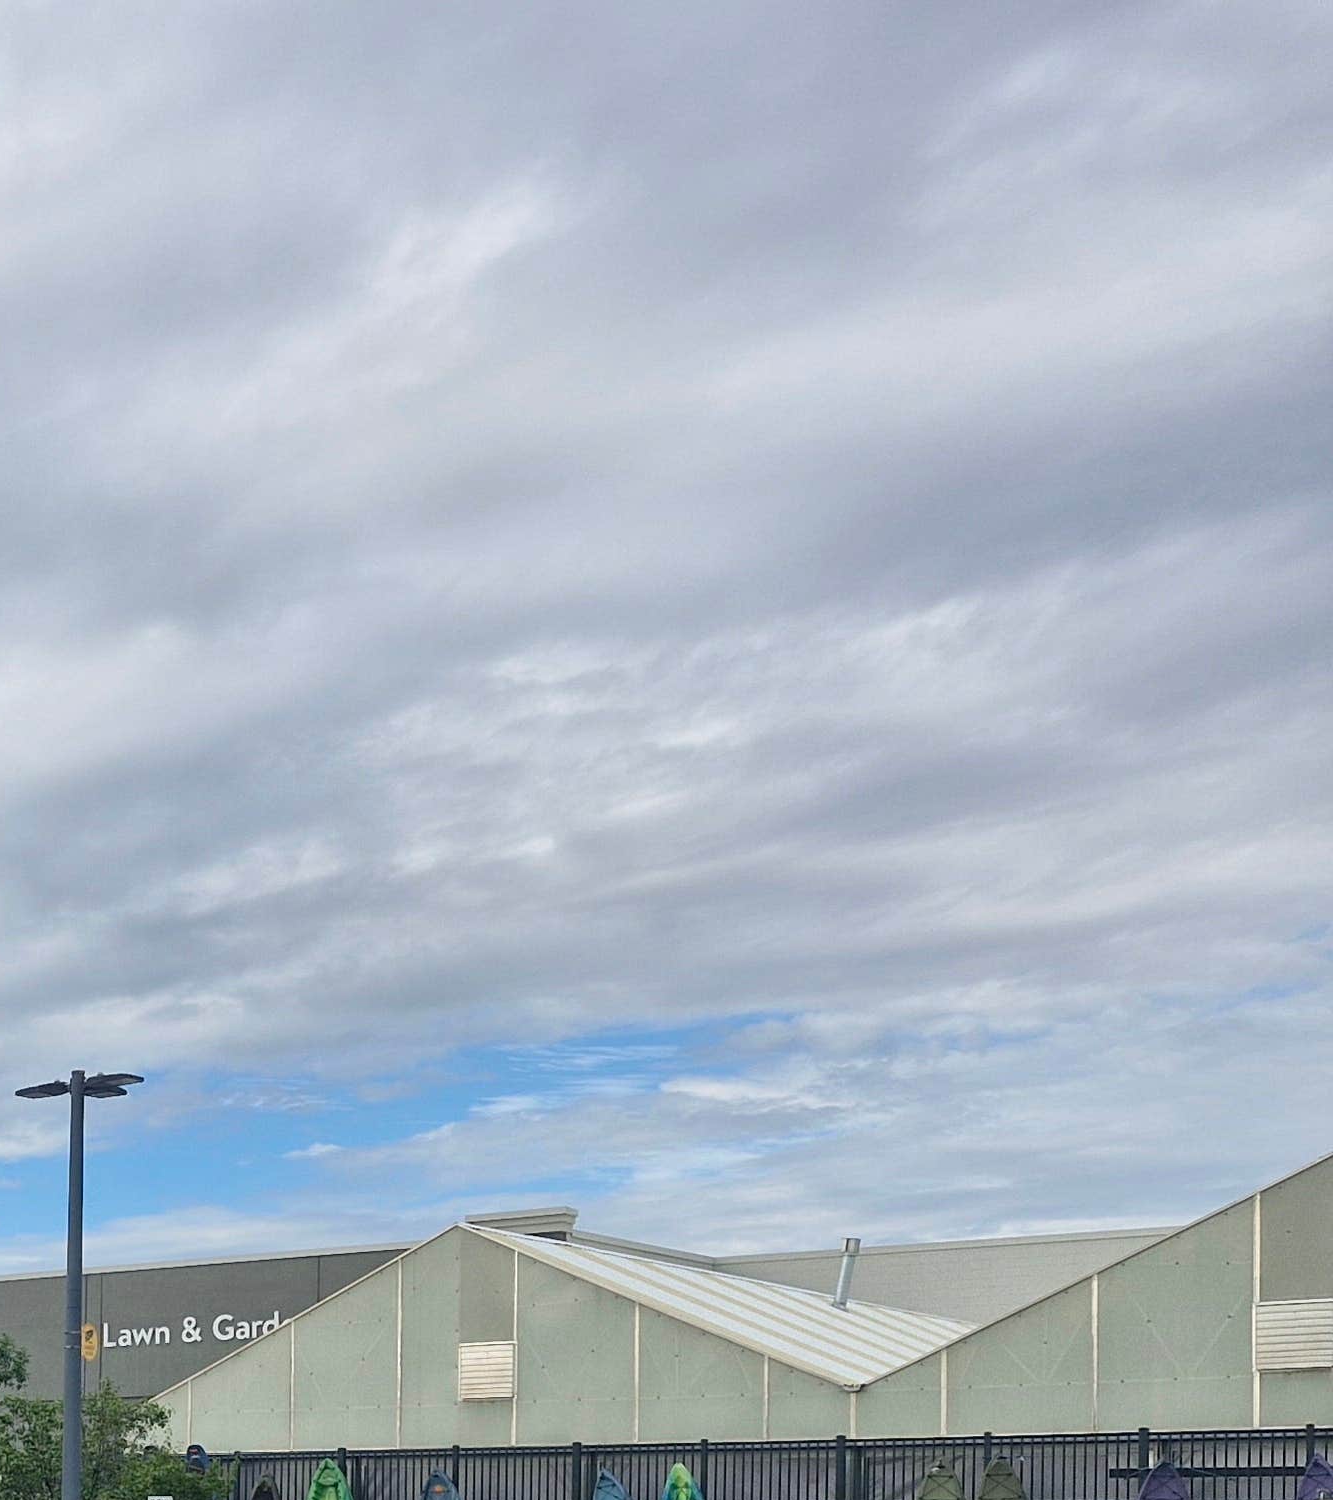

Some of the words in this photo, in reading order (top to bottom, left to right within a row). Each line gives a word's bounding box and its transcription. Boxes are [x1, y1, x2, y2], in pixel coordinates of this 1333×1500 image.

[102, 1322, 171, 1348] Lawn
[181, 1316, 202, 1343] &
[212, 1310, 293, 1342] Gard
